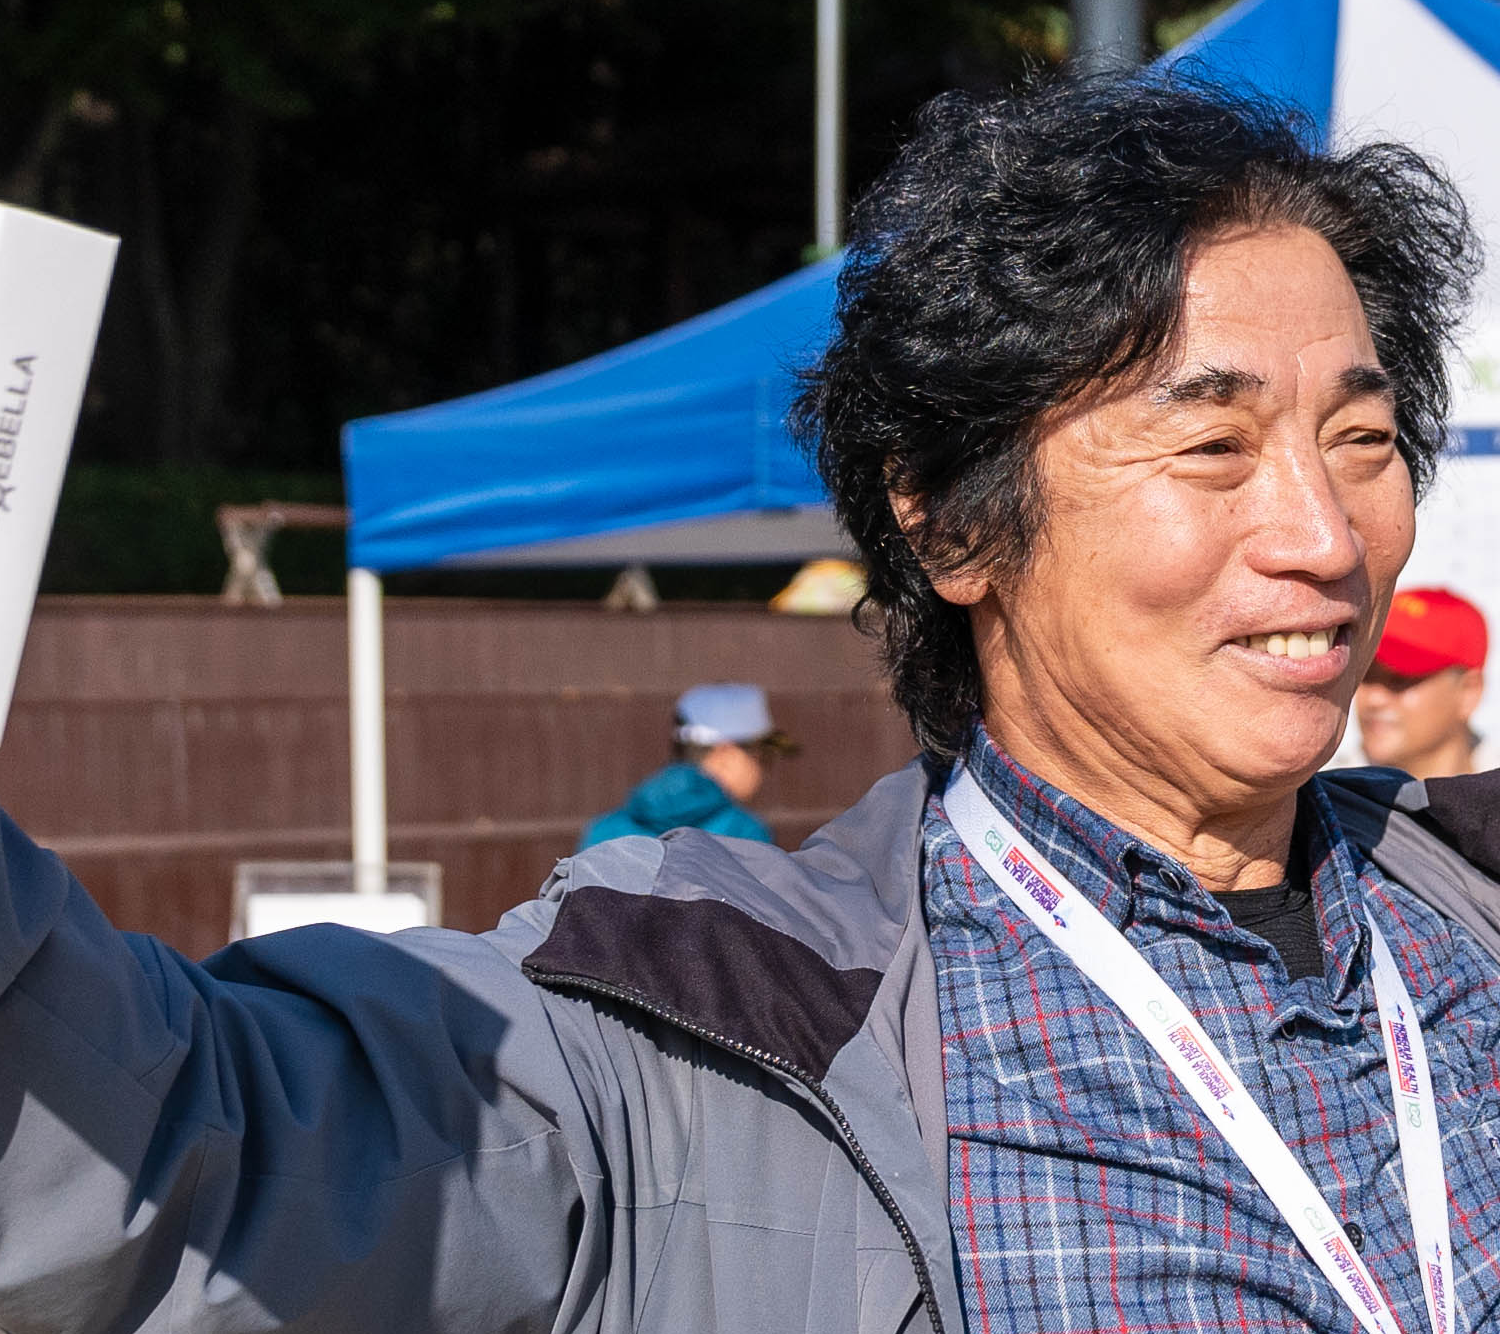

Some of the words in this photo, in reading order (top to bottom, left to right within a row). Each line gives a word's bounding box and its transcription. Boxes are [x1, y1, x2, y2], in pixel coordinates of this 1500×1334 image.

[1000, 855, 1027, 884] HEALTH
[1022, 879, 1055, 914] MONGOLIA
[1167, 1030, 1195, 1063] HEALTH
[1397, 1021, 1413, 1059] MONGOLIA
[1190, 1060, 1224, 1101] MONGOLIA
[1322, 1240, 1349, 1274] HEALTH
[1345, 1273, 1376, 1315] MONGOLIA
